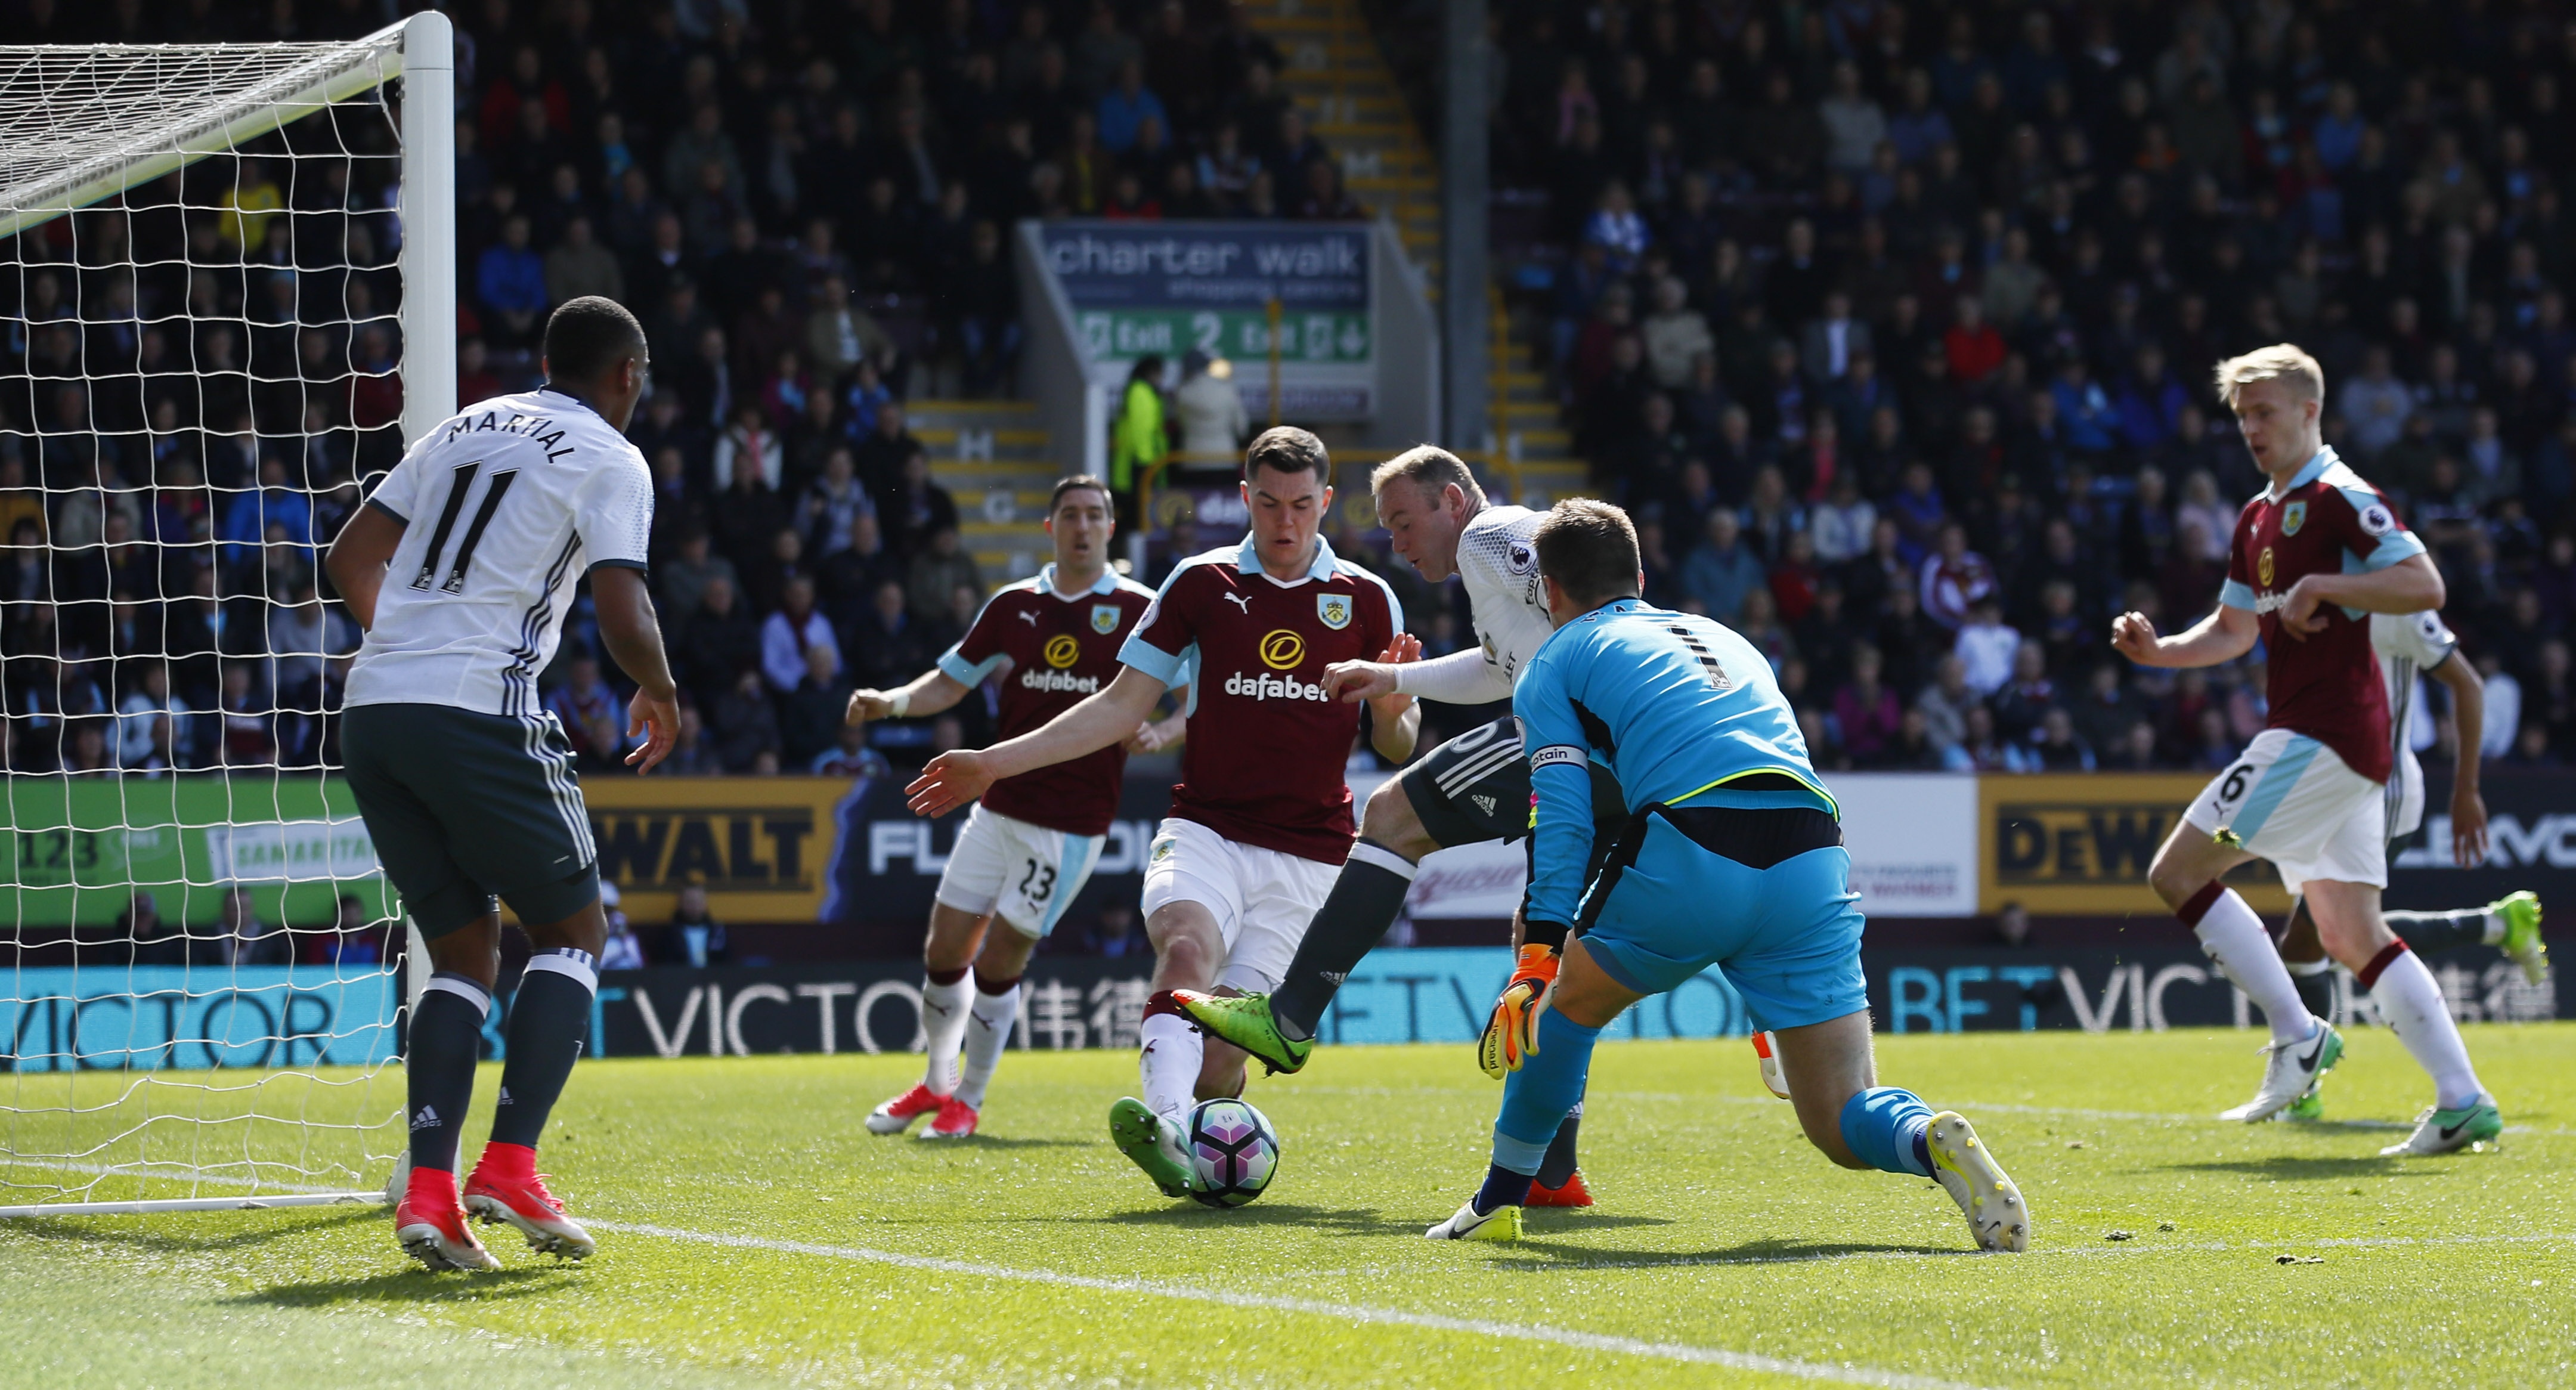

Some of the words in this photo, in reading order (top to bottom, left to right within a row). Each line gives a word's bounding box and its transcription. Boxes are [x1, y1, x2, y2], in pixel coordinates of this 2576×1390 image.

[1052, 233, 1240, 275] charter
[1255, 235, 1360, 275] walk
[449, 411, 575, 464] MARTIAL
[407, 459, 521, 596] 11
[1021, 668, 1099, 694] dafabet
[2219, 764, 2256, 803] 6
[1471, 794, 1494, 818] adidas
[18, 831, 98, 869] 123
[1018, 857, 1057, 902] 23
[1488, 1025, 1500, 1070] precision
